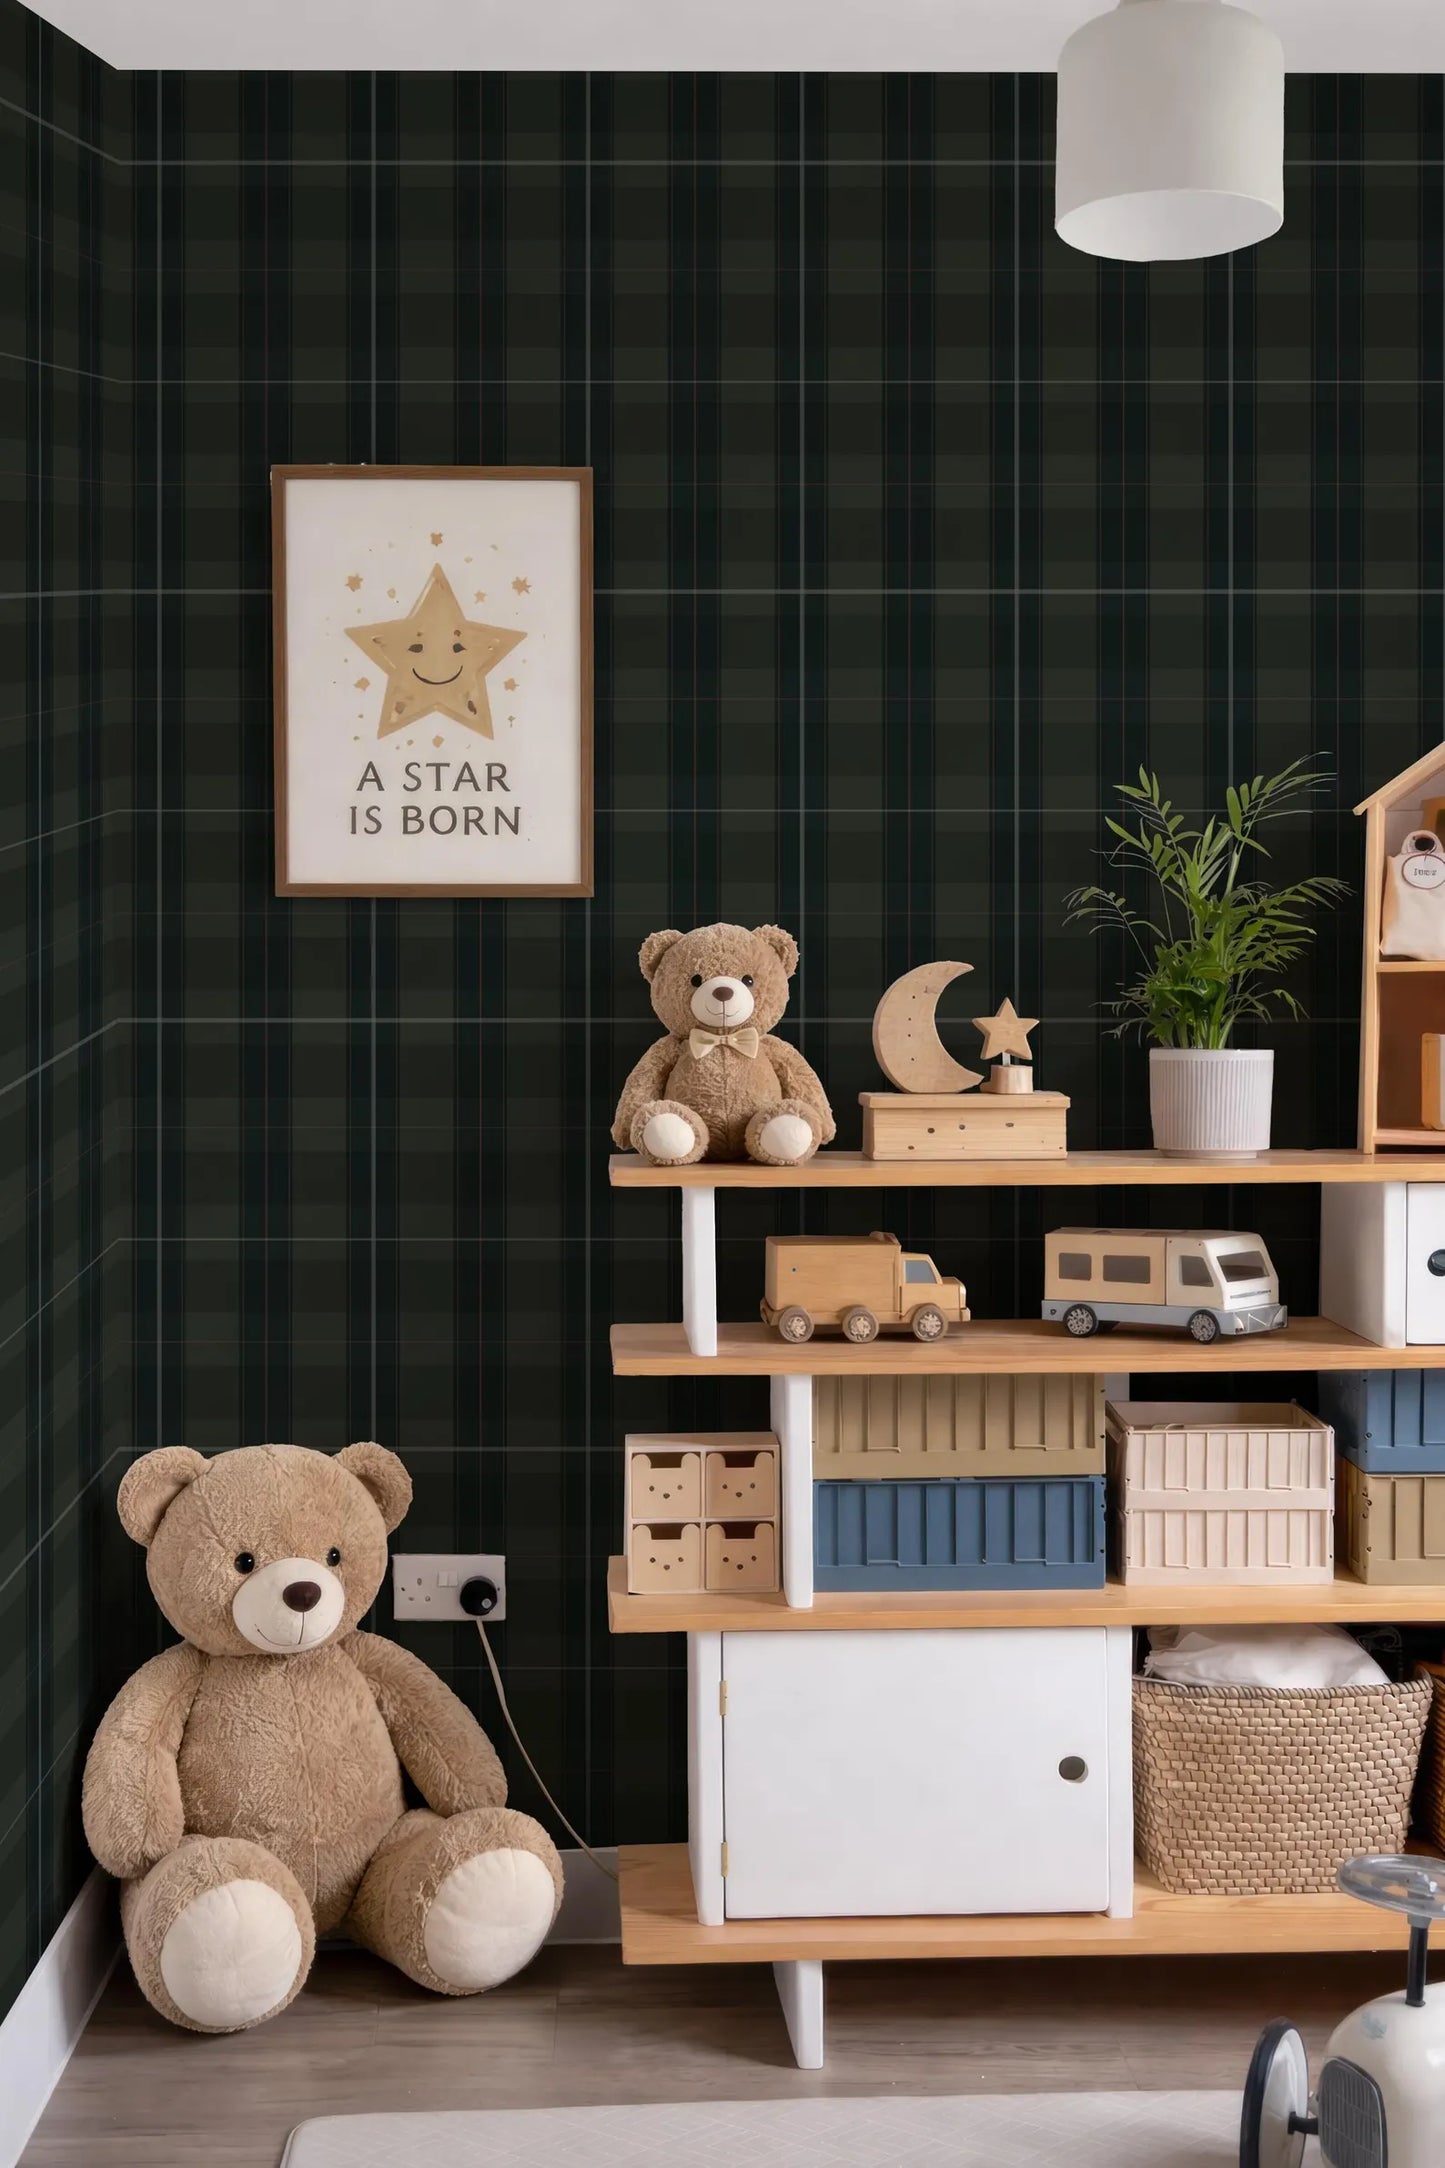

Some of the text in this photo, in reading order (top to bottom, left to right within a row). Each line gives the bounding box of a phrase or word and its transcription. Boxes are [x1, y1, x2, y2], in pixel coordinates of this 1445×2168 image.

[356, 760, 511, 792] A STAR
[349, 805, 521, 836] IS BORN
